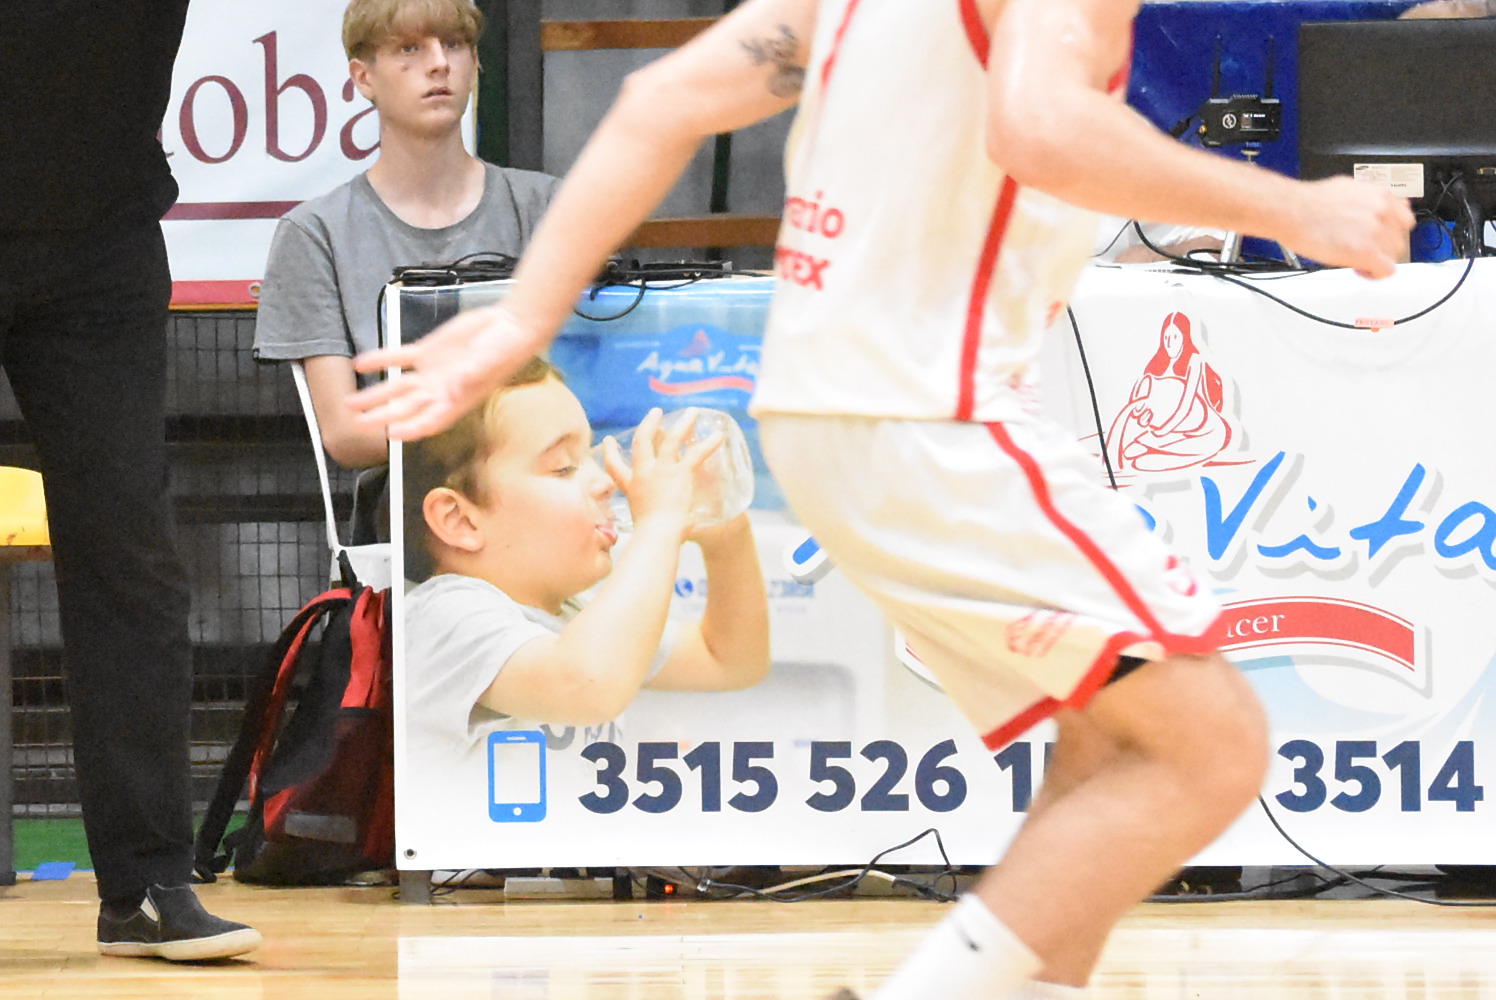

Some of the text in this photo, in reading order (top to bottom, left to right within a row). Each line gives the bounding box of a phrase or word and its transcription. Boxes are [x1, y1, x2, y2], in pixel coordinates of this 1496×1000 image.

[1200, 451, 1496, 571] Vita
[1225, 613, 1285, 639] cer
[578, 738, 1057, 814] 3515 526 1
[1274, 739, 1485, 813] 3514
